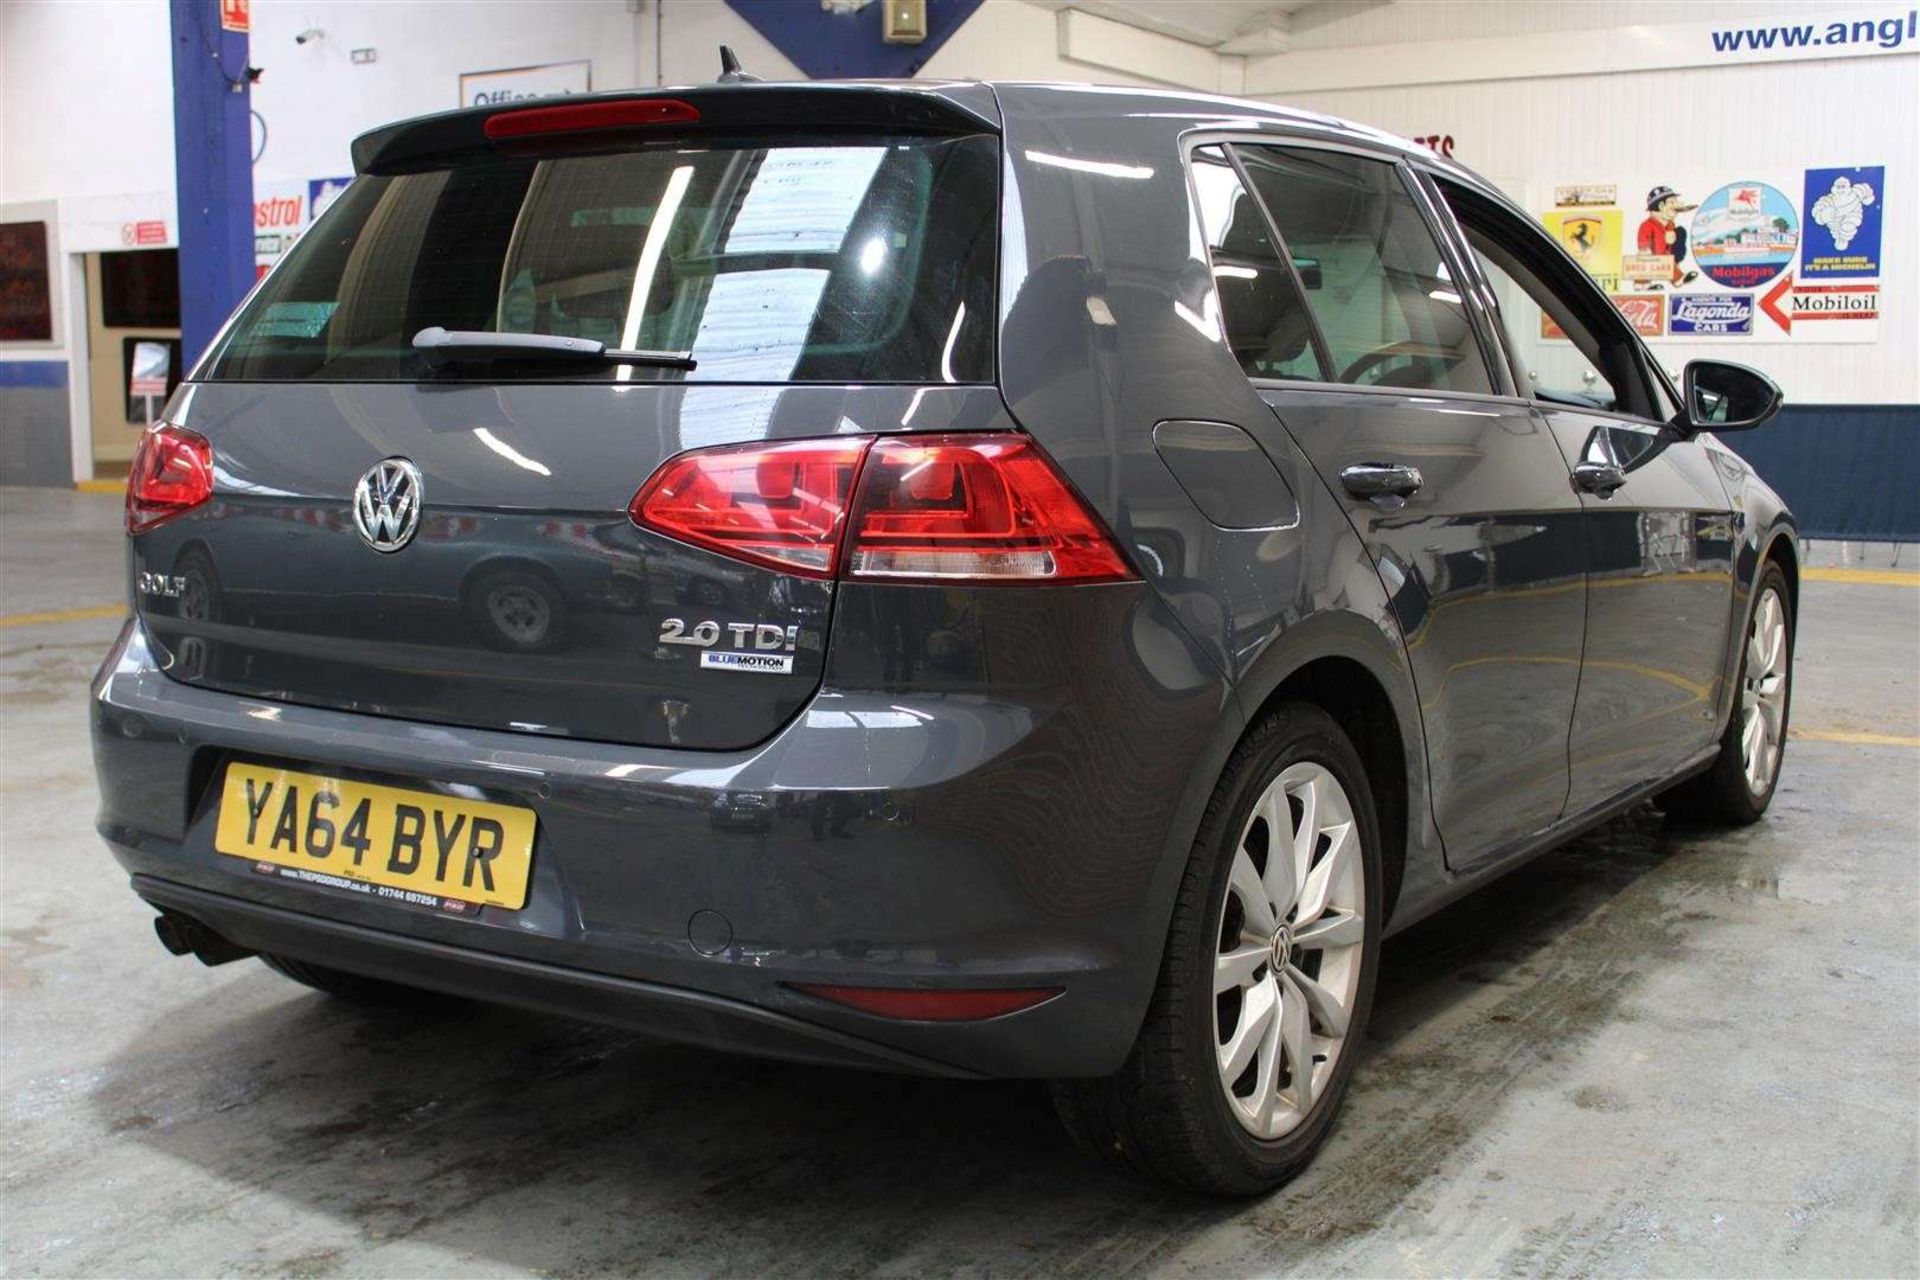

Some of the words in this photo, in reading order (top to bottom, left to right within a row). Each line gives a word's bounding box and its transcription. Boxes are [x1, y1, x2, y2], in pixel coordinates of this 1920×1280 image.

[253, 195, 303, 227] strol
[1711, 265, 1776, 279] Mobilgas
[1672, 300, 1750, 323] Lagonda
[1792, 294, 1877, 310] Mobiloil
[1693, 323, 1728, 332] CARS
[246, 778, 372, 866] YA64
[386, 803, 505, 893] BYR
